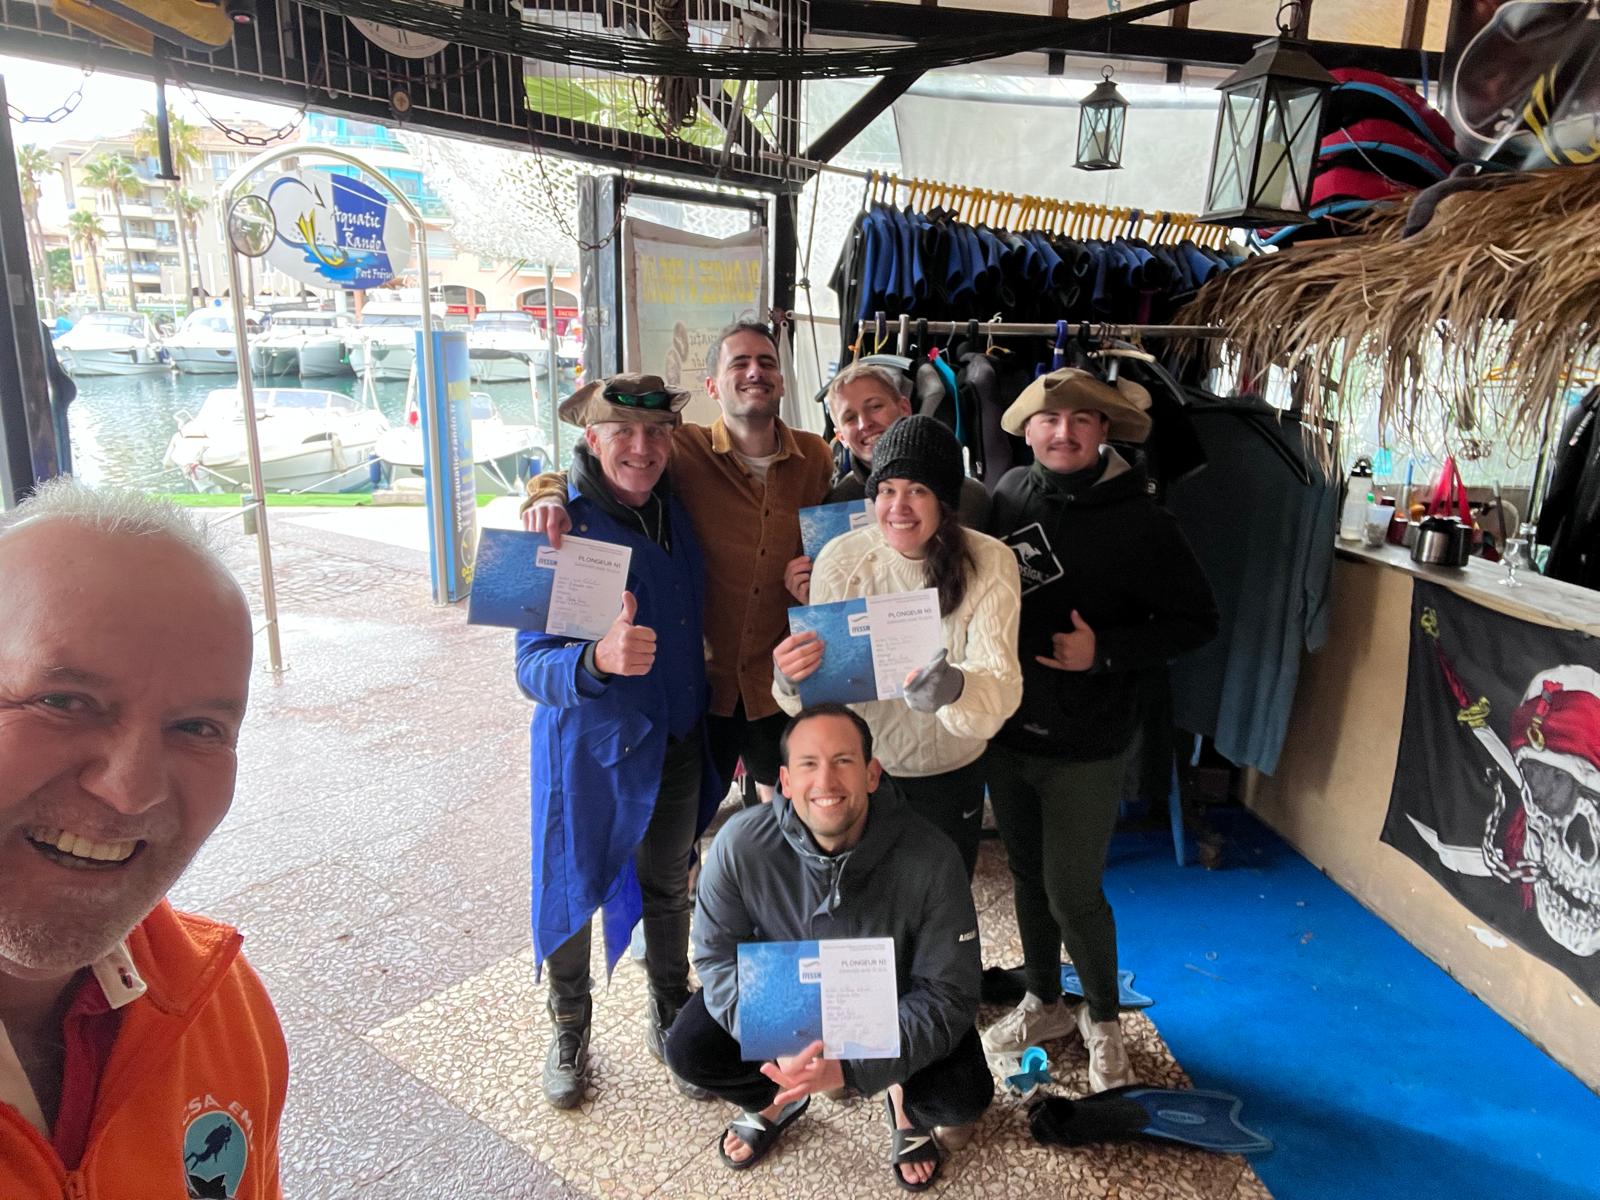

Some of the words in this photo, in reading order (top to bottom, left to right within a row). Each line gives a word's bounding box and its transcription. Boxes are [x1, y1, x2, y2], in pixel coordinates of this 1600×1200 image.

[330, 205, 382, 232] Aquatic
[340, 232, 382, 250] Rando
[577, 555, 614, 568] PLONGEUR
[887, 609, 924, 619] PLONGEUR
[841, 959, 878, 968] PLONGEUR
